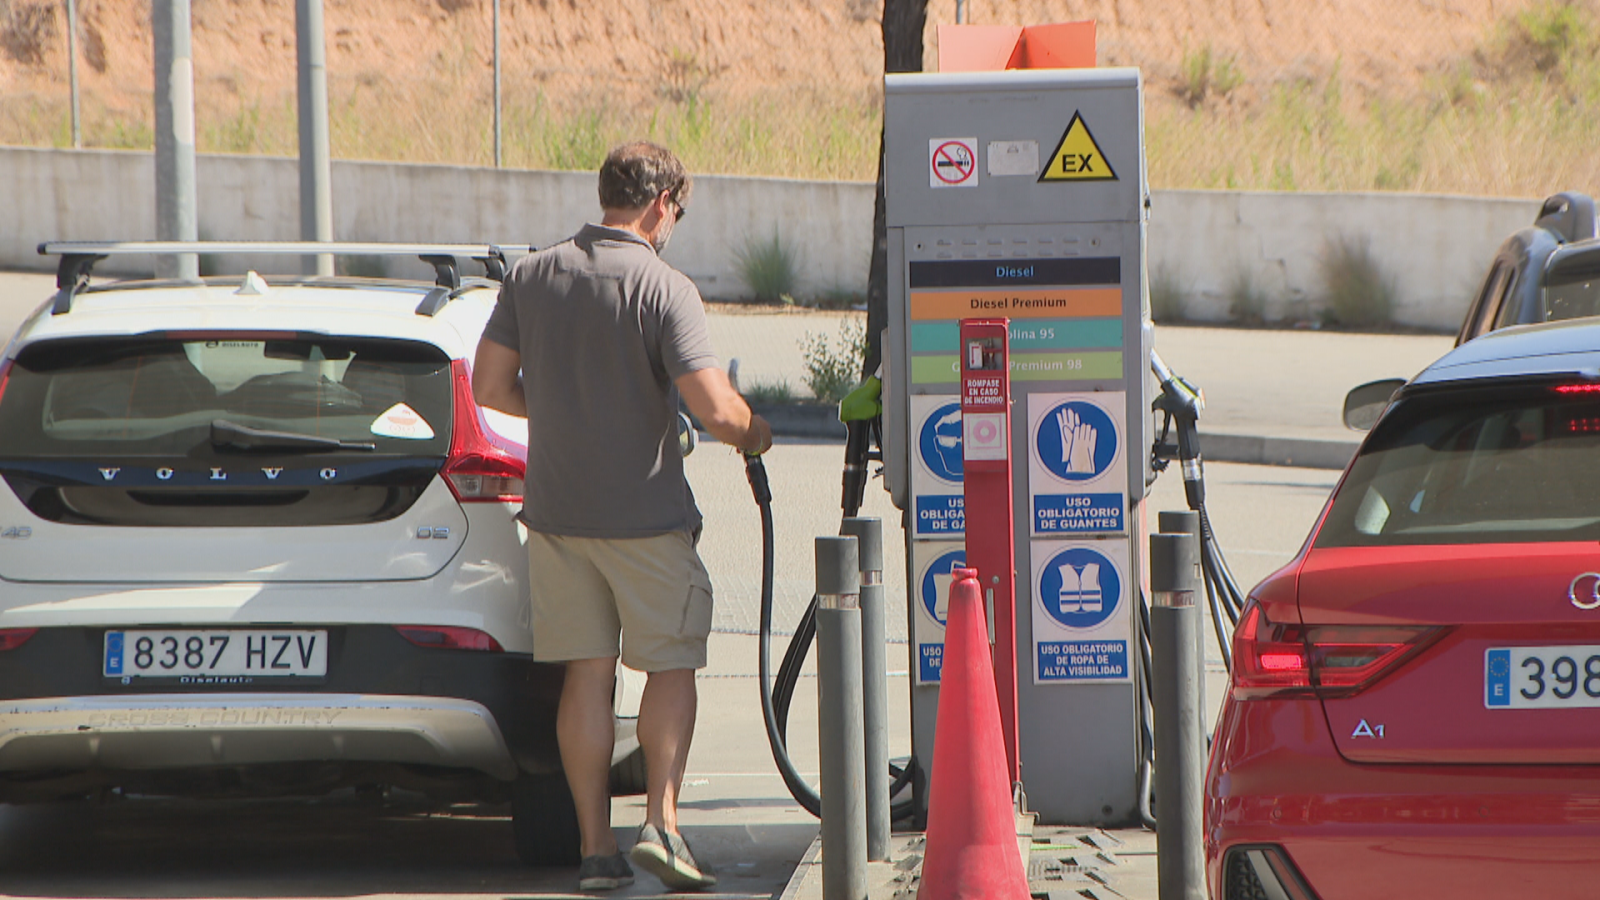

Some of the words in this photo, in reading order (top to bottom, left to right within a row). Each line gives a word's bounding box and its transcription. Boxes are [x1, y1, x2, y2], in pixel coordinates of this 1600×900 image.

[1062, 154, 1093, 173] EX
[996, 265, 1034, 277] Diesel
[970, 298, 1008, 309] Diesel
[1012, 297, 1067, 308] Premium
[1008, 329, 1036, 339] olina
[1039, 328, 1055, 339] 95
[1009, 360, 1063, 371] Premium
[1067, 359, 1082, 370] 98
[967, 379, 1000, 387] ROMPASE
[969, 388, 979, 396] EN
[980, 387, 999, 396] CASO
[964, 396, 972, 404] DE
[974, 396, 1003, 404] INCENDIO
[98, 467, 338, 480] VOLVO
[948, 498, 964, 508] US
[1066, 497, 1091, 507] USO
[920, 509, 965, 519] OBLIGA
[1038, 507, 1120, 518] OBLIGATORIO
[932, 520, 948, 529] DE
[1041, 519, 1056, 529] DE
[1060, 518, 1117, 529] GUANTES
[0, 525, 32, 539] 40
[416, 525, 450, 539] D2
[110, 657, 119, 667] E
[134, 636, 230, 669] 8387
[246, 635, 316, 669] HZV
[923, 646, 942, 656] USO
[1041, 644, 1060, 654] USO
[1062, 643, 1123, 654] OBLIGATORIO
[929, 658, 941, 667] DE
[1056, 656, 1068, 665] DE
[1070, 655, 1095, 665] ROPA
[1097, 654, 1109, 664] DE
[1044, 666, 1066, 676] ALTA
[1068, 665, 1122, 676] VISIBILIDAD
[1494, 683, 1504, 696] E
[88, 711, 189, 727] CROSS
[199, 709, 342, 726] COUNTRY
[1351, 719, 1385, 739] A1
